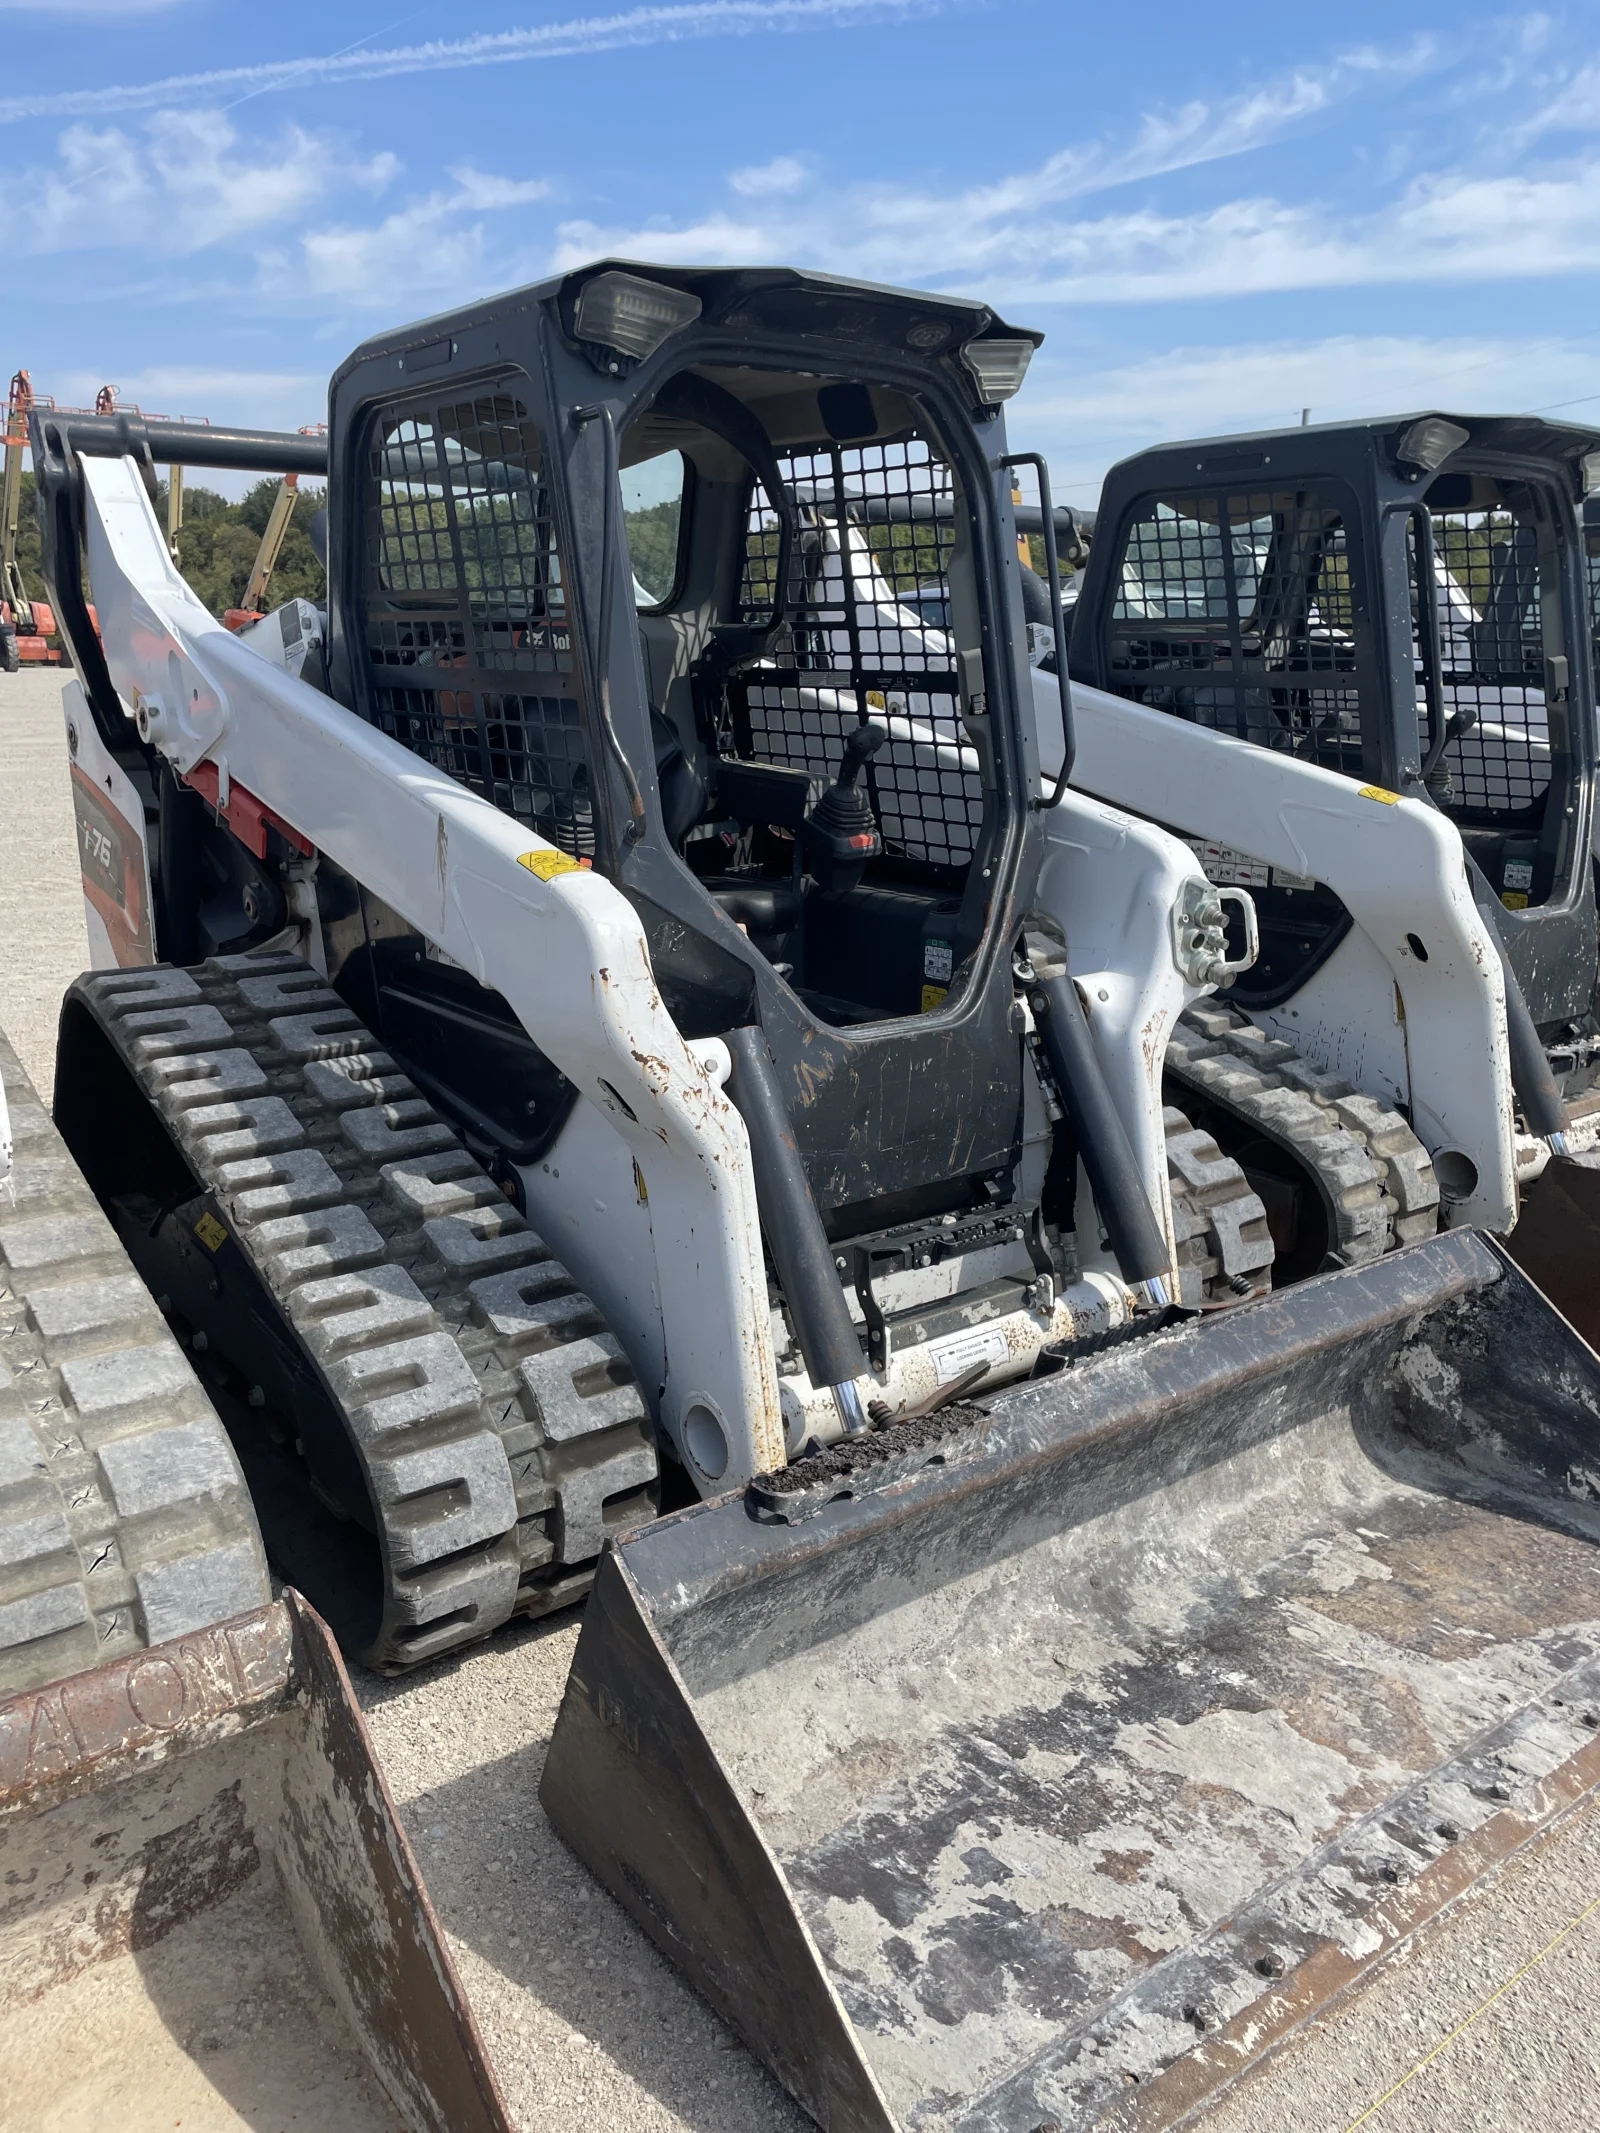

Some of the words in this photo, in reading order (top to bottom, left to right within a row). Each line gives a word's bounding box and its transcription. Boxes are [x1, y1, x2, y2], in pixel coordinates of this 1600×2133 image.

[956, 1346, 967, 1354] FULLY
[967, 1341, 982, 1350] ENGAGE
[956, 1351, 973, 1361] LOCKING
[973, 1347, 988, 1356] LEVERS
